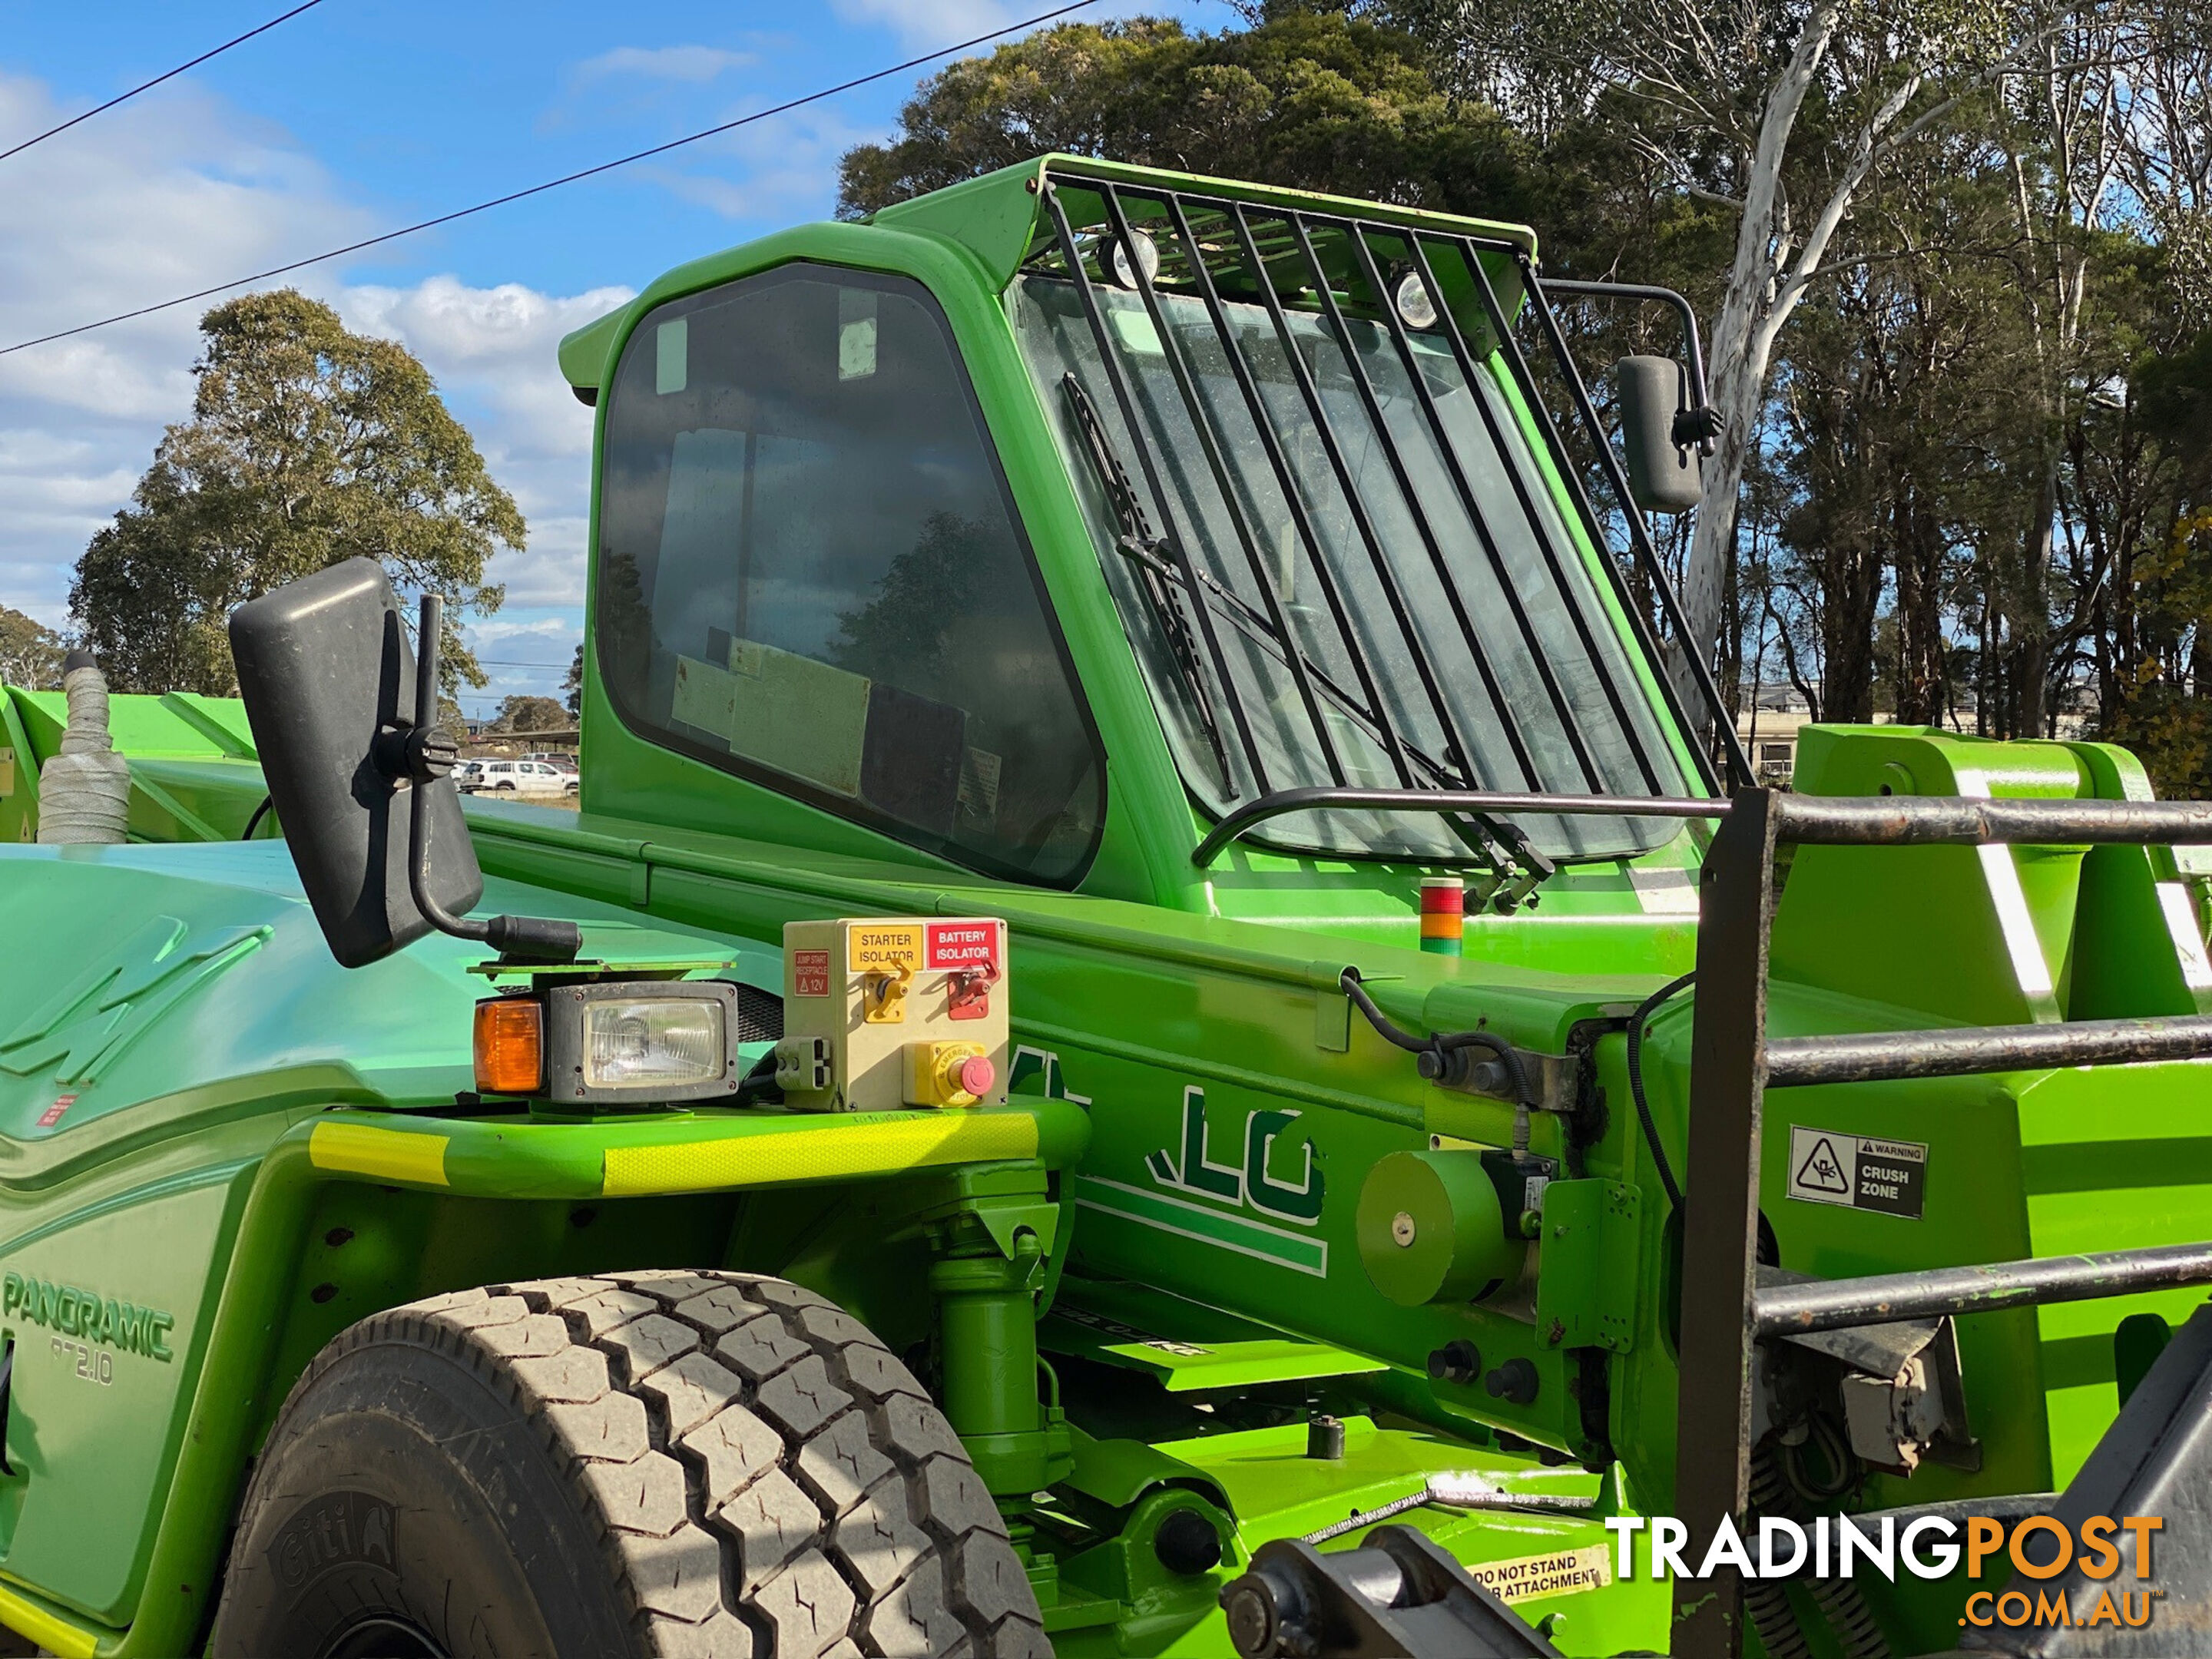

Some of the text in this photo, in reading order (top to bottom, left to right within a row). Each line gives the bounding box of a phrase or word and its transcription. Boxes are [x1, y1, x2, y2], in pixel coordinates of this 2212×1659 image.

[862, 935, 911, 946] STARTER
[939, 931, 986, 944] BATTERY
[810, 955, 826, 964] START
[859, 951, 914, 962] ISOLATOR
[936, 947, 989, 960] ISOLATOR
[796, 966, 827, 975] RECEPTACLE
[810, 979, 823, 991] 12V
[1875, 1144, 1921, 1159] WARNING
[1861, 1164, 1909, 1184] CRUSH
[1860, 1181, 1899, 1200] ZONE
[3, 1271, 175, 1364] PANORAMIC
[280, 1503, 353, 1588] Giti
[1474, 1556, 1577, 1584] DO NOT STAND
[1505, 1568, 1595, 1598] ATTACHMENT
